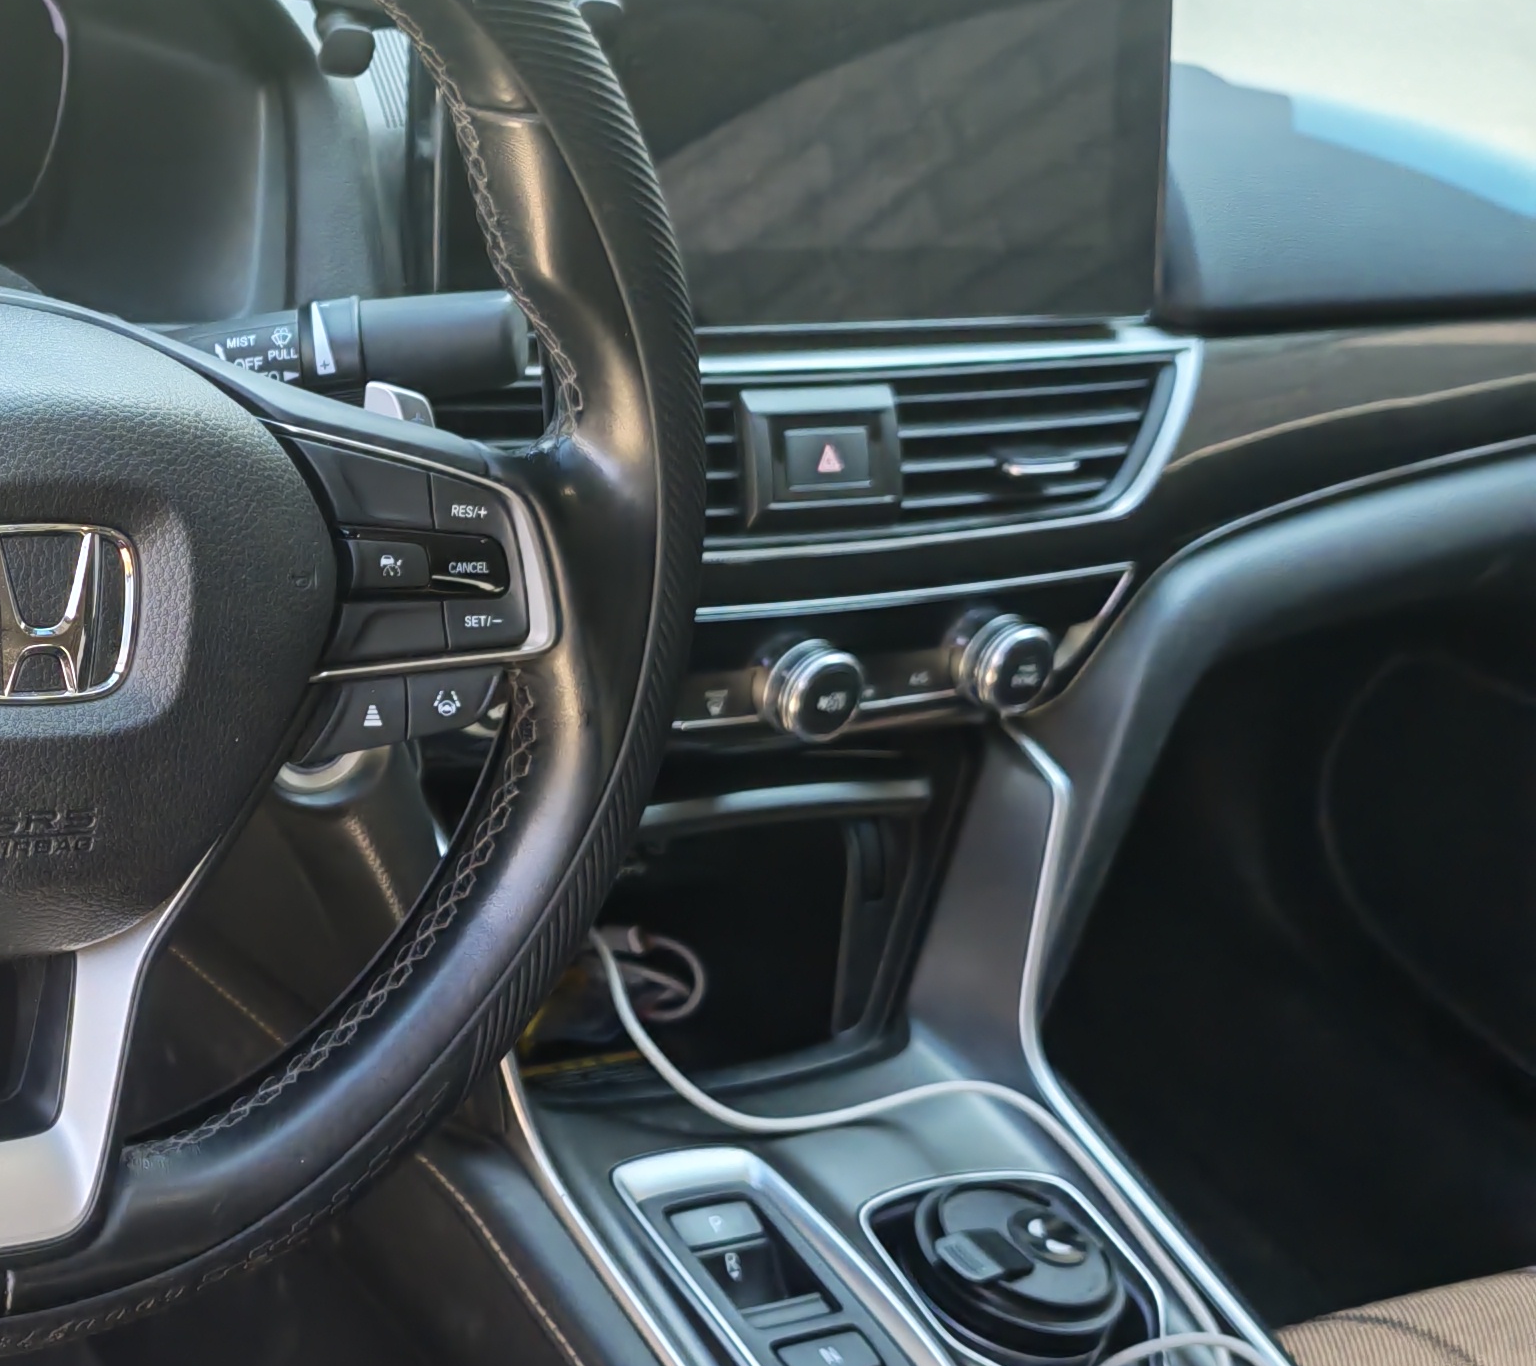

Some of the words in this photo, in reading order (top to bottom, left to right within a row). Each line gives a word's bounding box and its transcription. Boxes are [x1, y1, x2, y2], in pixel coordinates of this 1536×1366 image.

[227, 335, 256, 349] MIST
[268, 347, 298, 361] PULL
[448, 561, 490, 575] CANCEL
[708, 1215, 722, 1233] P
